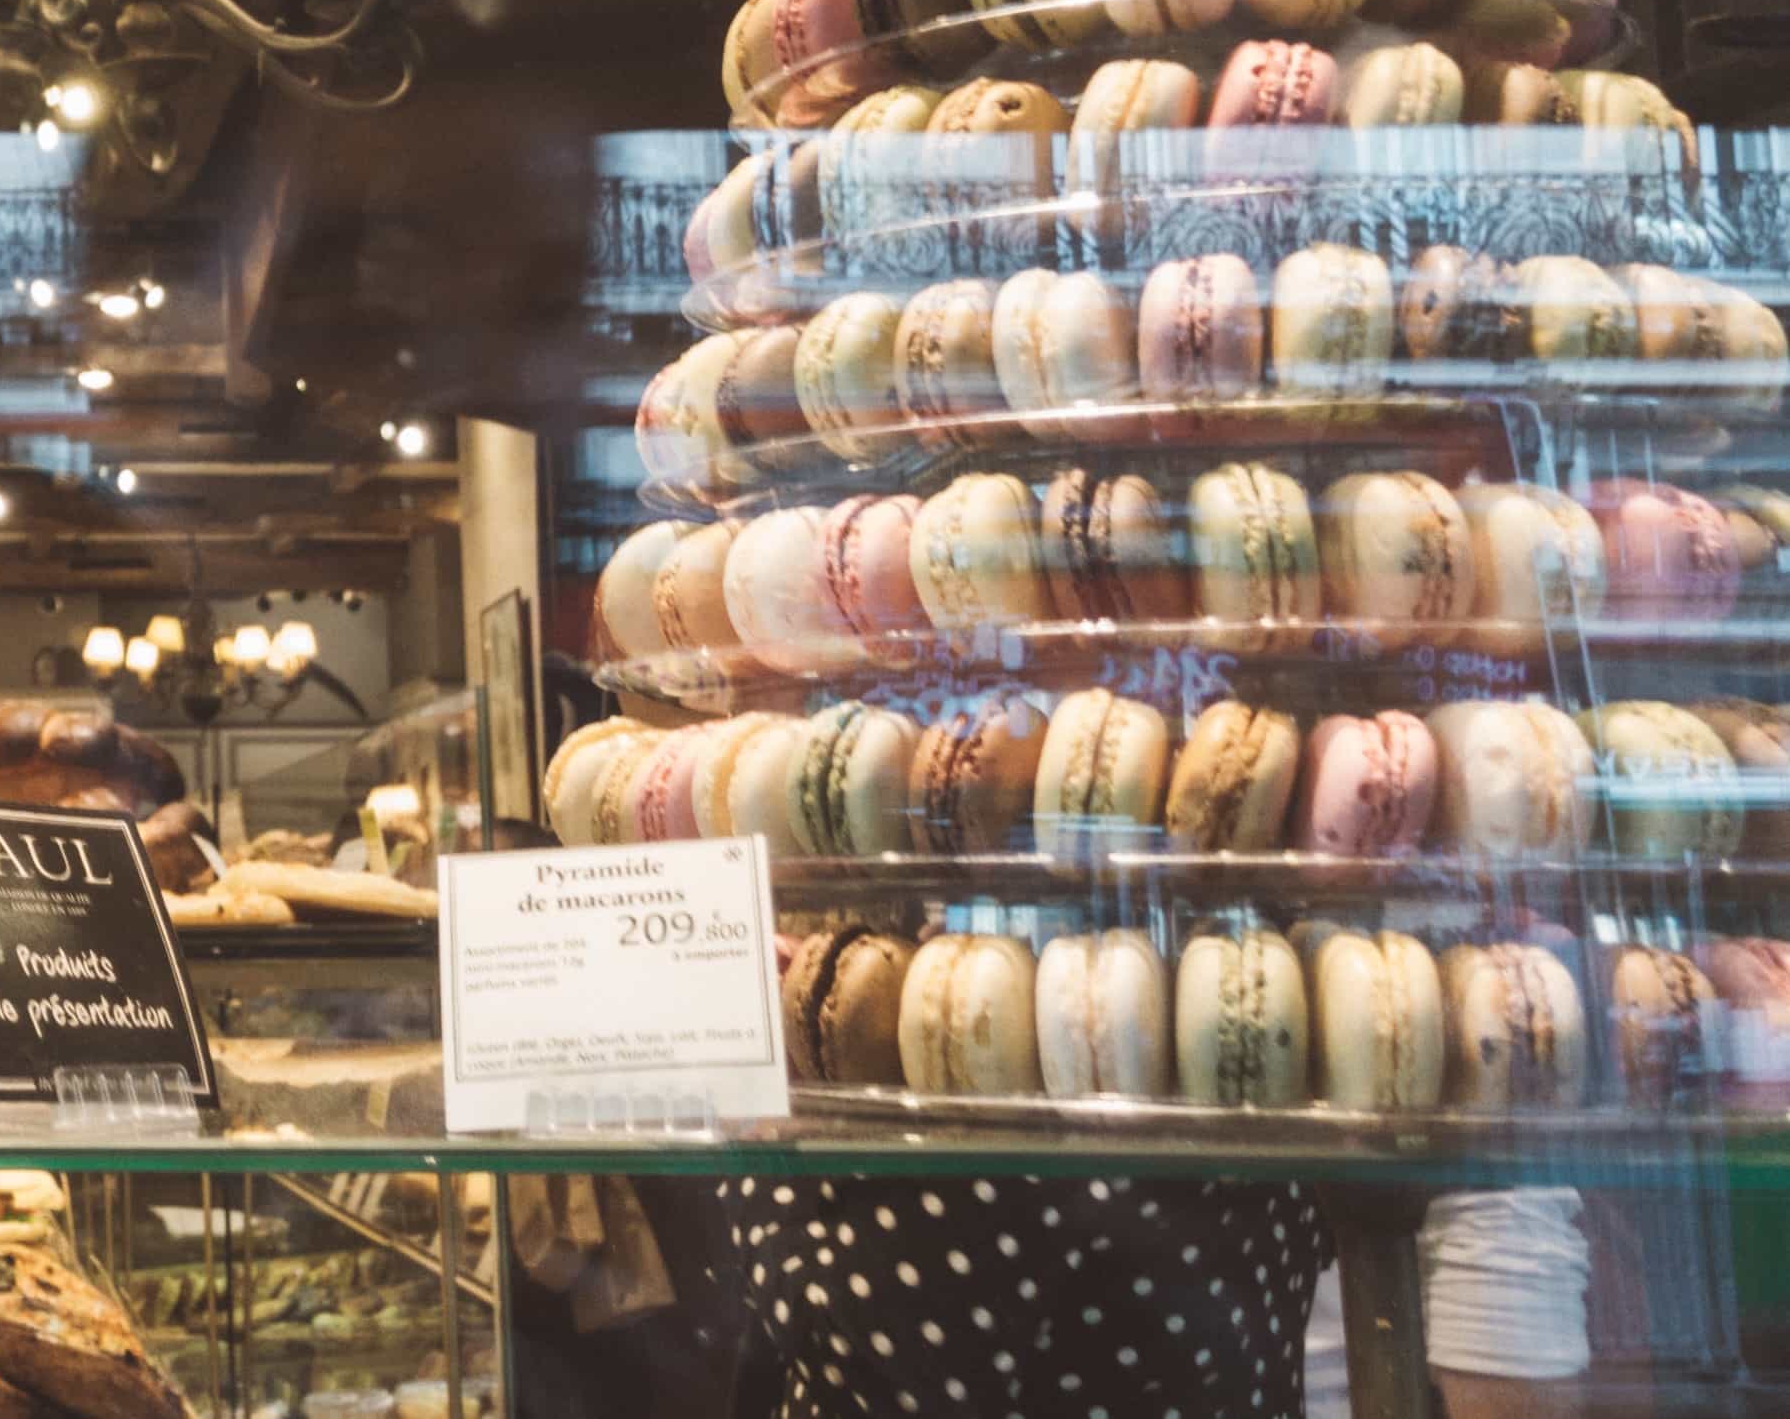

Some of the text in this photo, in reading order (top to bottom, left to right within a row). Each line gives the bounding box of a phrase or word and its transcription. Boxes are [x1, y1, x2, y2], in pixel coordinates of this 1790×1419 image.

[536, 858, 664, 886] Pyramide
[518, 888, 685, 914] de macarons
[15, 944, 117, 983] Produits
[27, 991, 174, 1038] présentation
